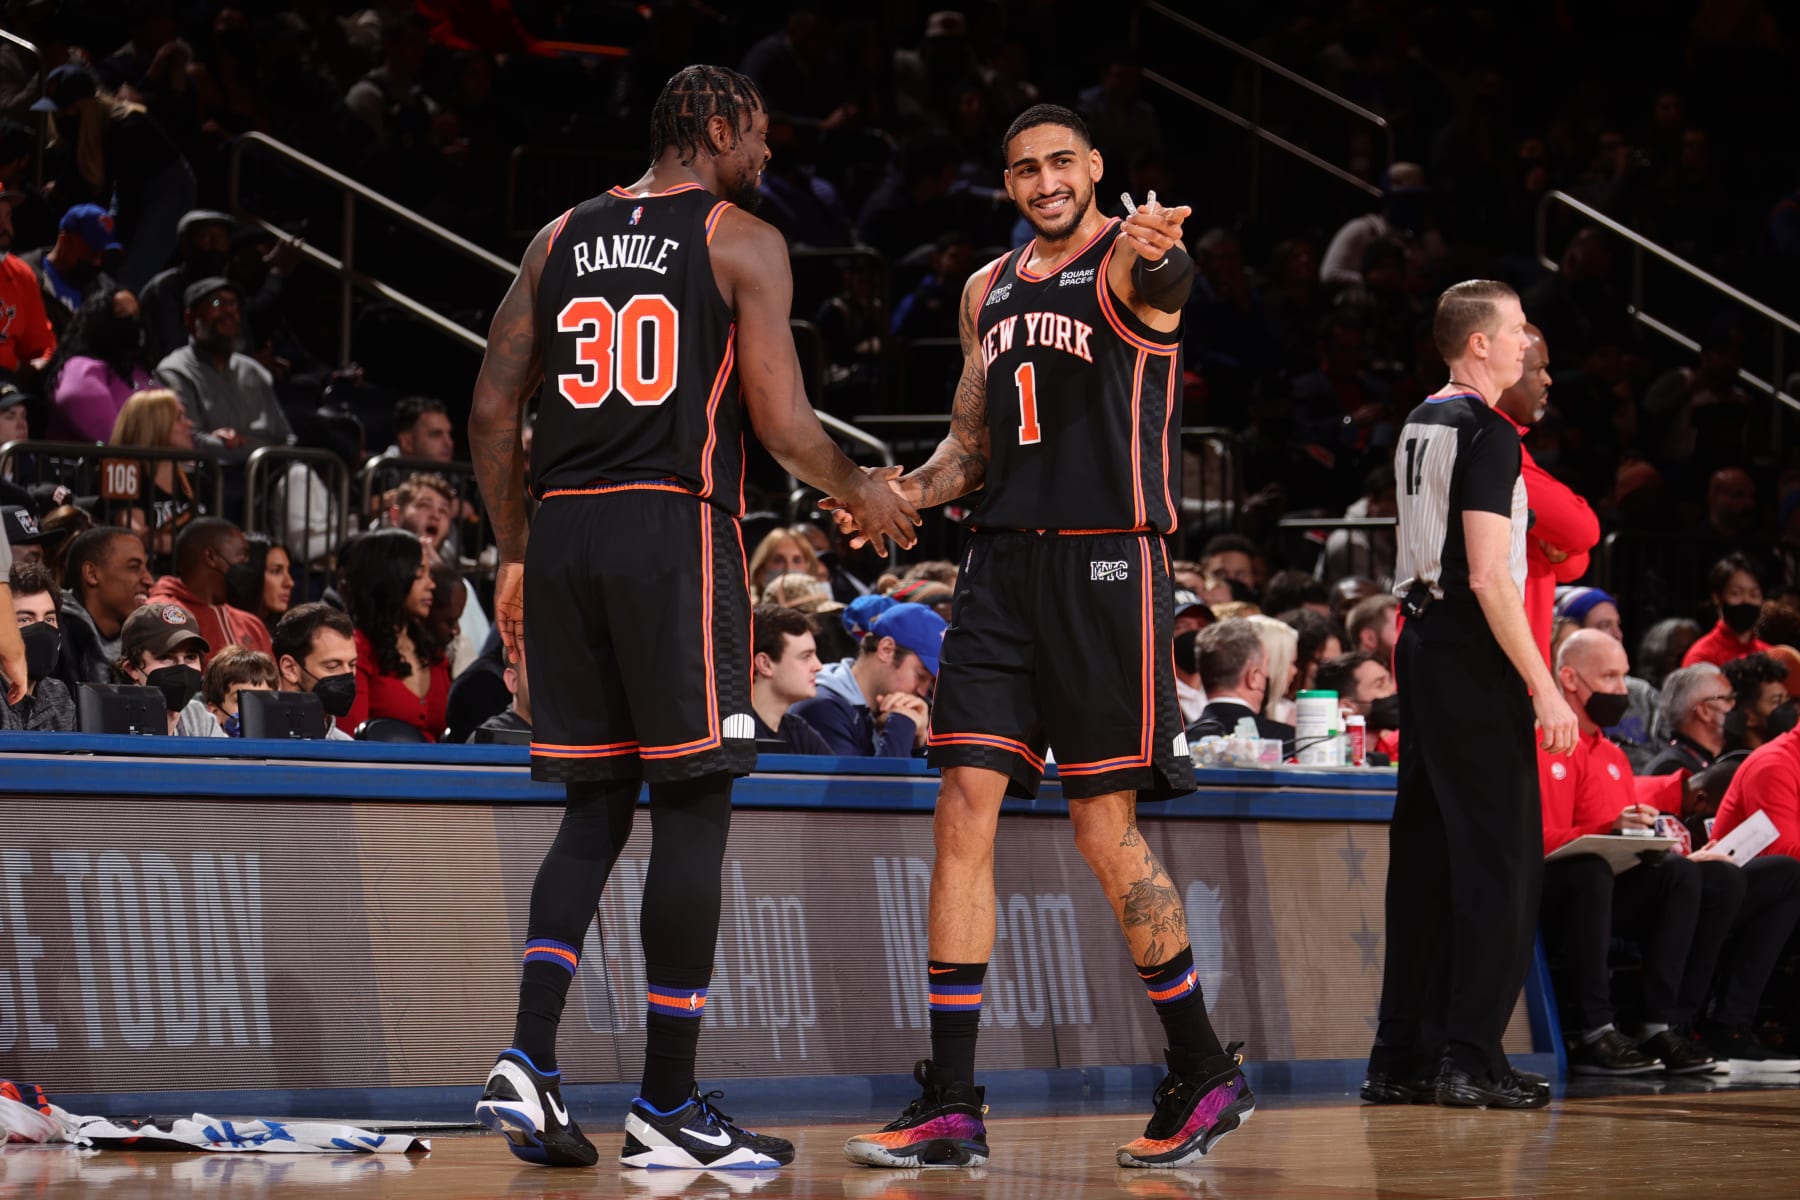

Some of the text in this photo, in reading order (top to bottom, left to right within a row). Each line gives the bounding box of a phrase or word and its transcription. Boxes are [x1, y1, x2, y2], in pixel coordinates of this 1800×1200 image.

[573, 234, 680, 278] RANDLE
[1061, 268, 1095, 280] SQUARE
[1059, 278, 1088, 287] SPACE
[557, 294, 679, 409] 30
[981, 312, 1093, 369] NEW YORK
[1014, 362, 1042, 446] 1
[107, 464, 137, 495] 106
[1090, 560, 1128, 581] NYC
[0, 849, 273, 1048] E TODAY
[731, 860, 816, 1060] App
